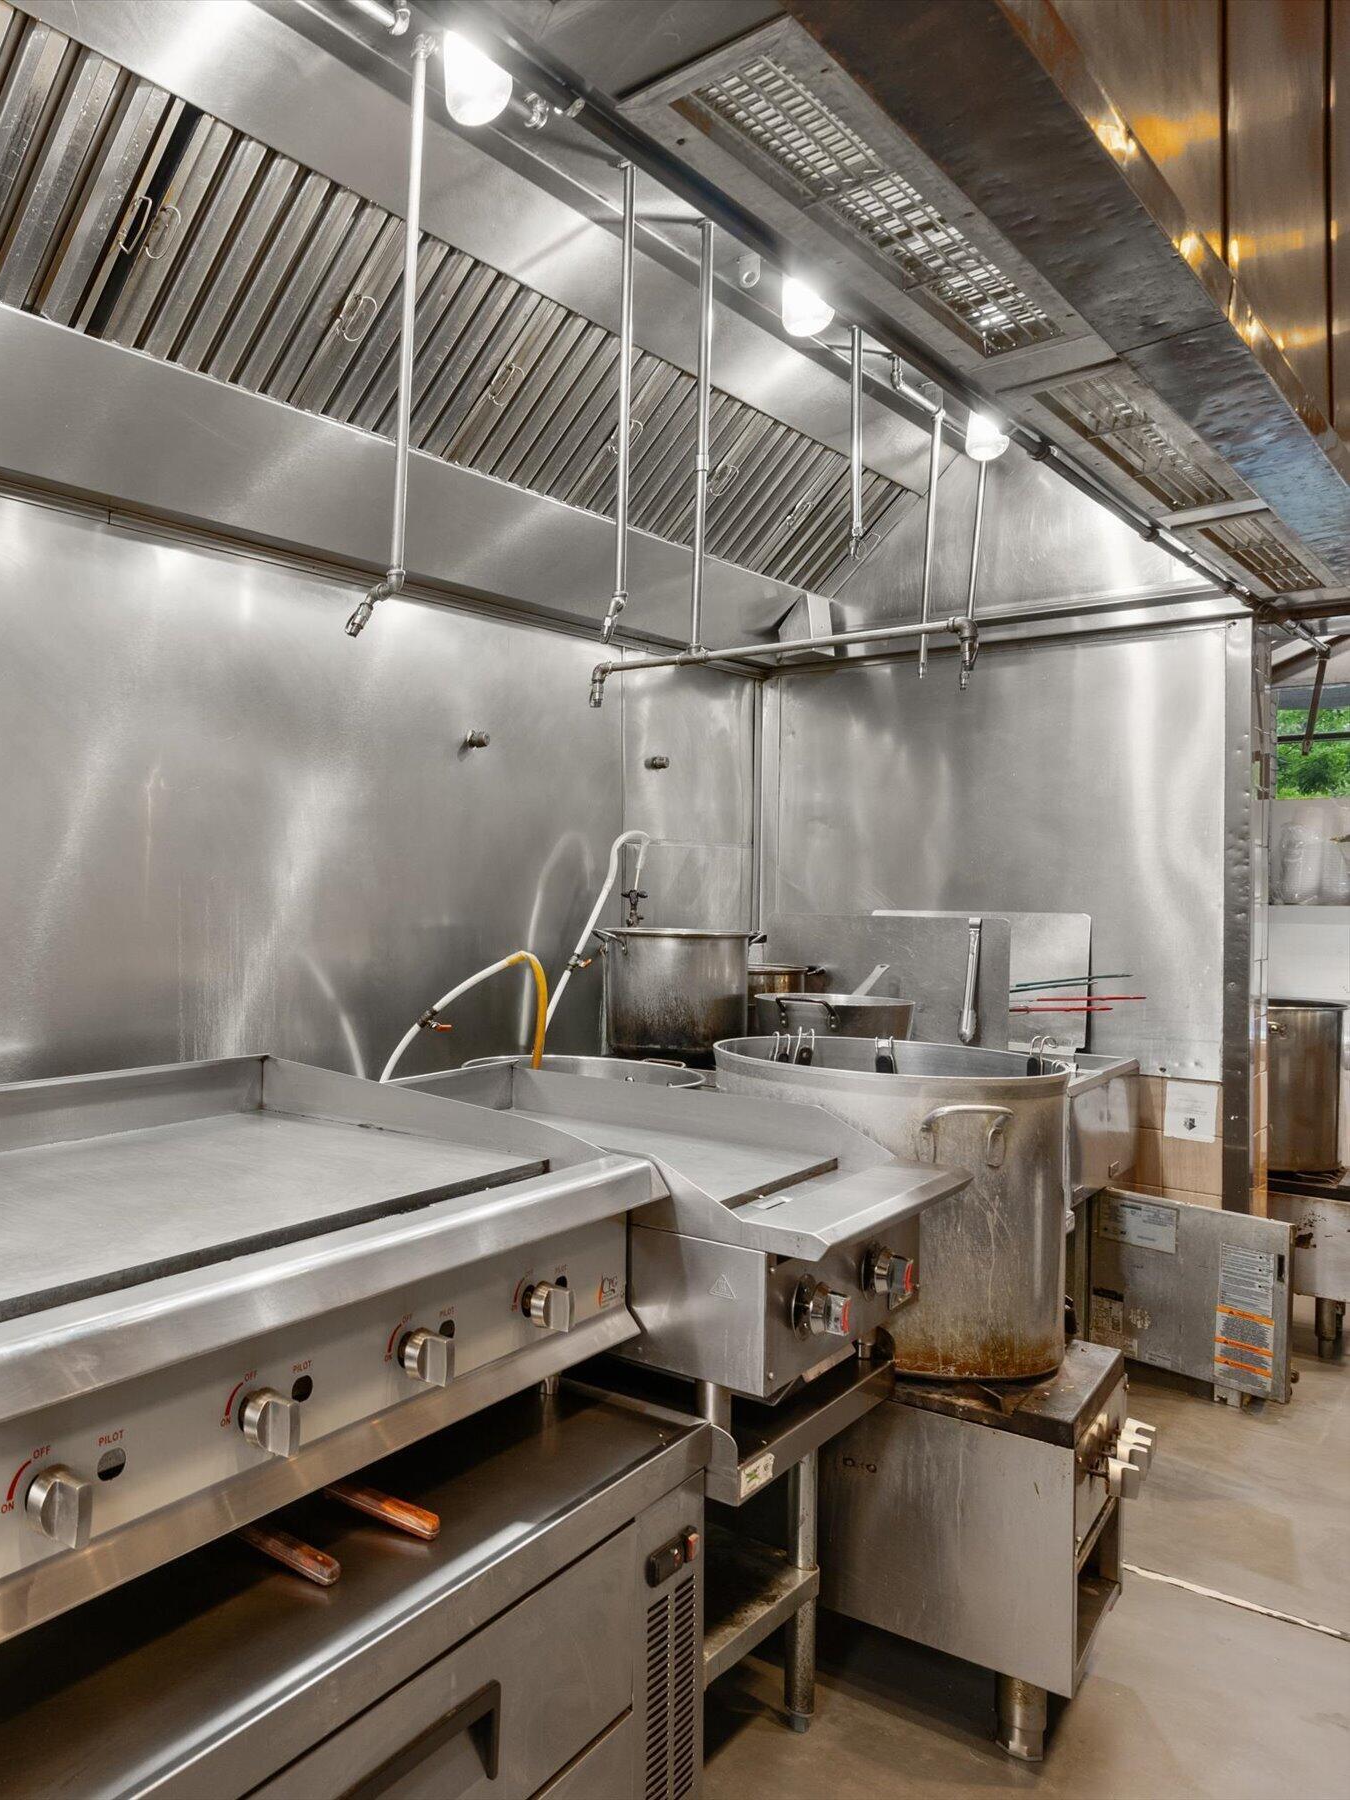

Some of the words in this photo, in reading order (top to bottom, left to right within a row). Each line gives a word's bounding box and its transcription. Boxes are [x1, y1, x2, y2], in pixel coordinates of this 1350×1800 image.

[293, 1360, 312, 1374] PILOT
[244, 1370, 257, 1382] OFF
[220, 1416, 231, 1427] ON
[98, 1430, 124, 1447] PILOT
[33, 1445, 51, 1460] OFF
[0, 1501, 15, 1514] ON
